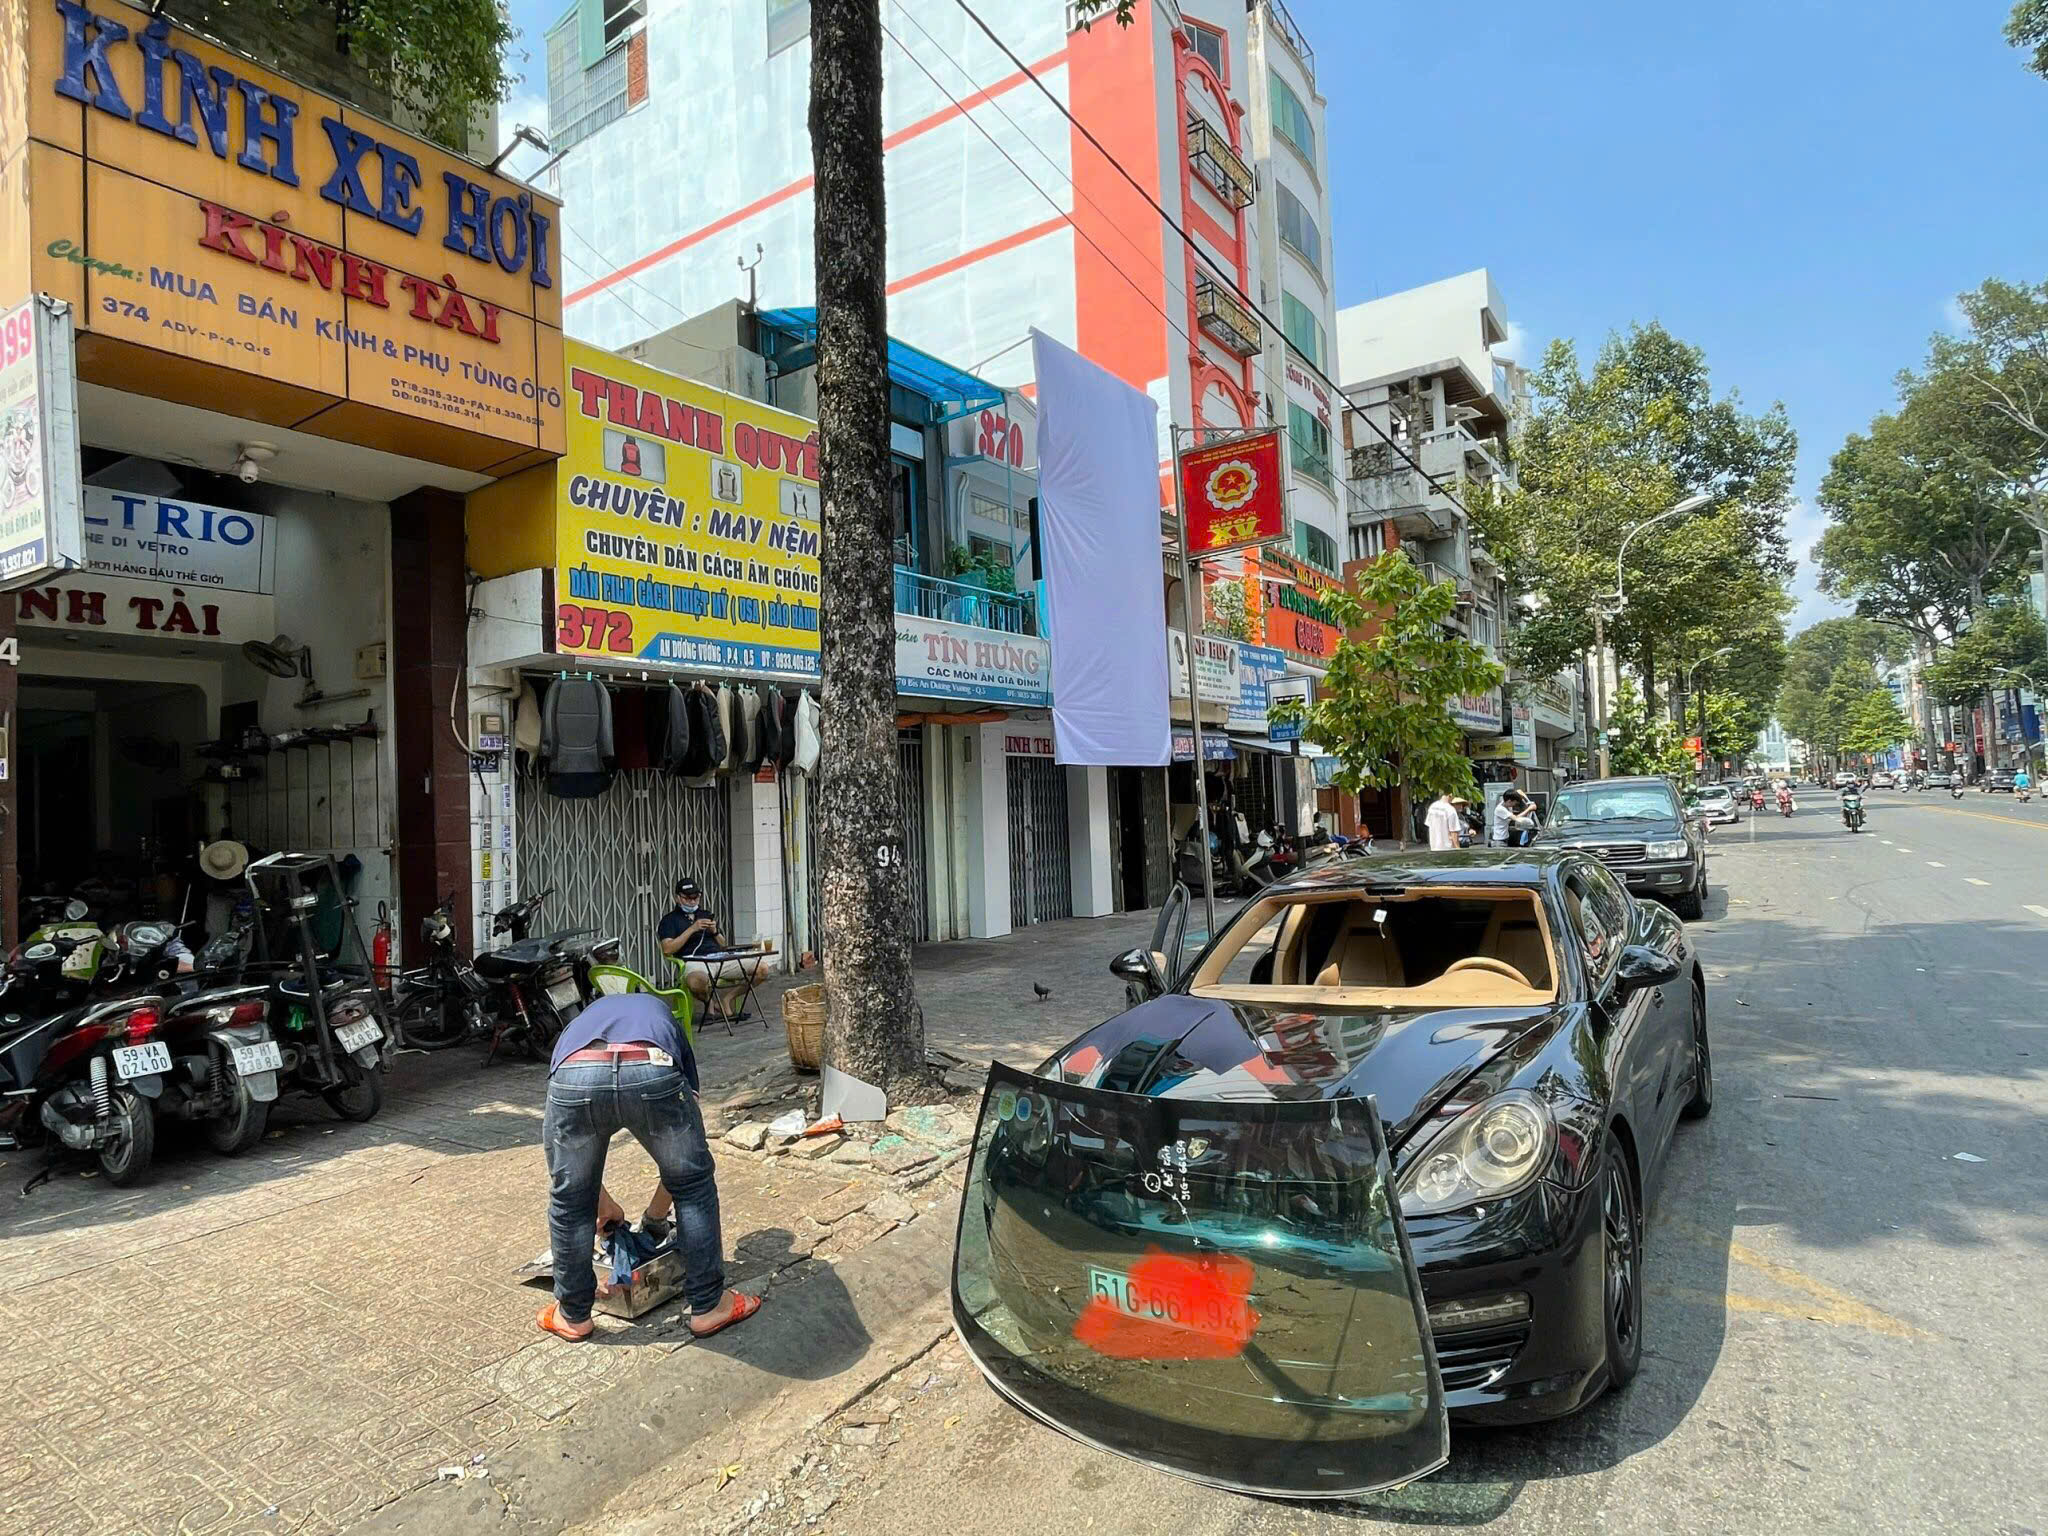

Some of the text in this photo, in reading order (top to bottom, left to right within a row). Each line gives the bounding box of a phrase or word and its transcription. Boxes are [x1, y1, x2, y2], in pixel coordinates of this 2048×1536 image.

[54, 1, 553, 289] KÍNH XE HƠI
[199, 201, 503, 344] KÍNH TÀI
[102, 296, 150, 323] 374
[150, 267, 218, 305] MUA
[238, 296, 298, 329] BÁN
[315, 316, 377, 358] KÍNH
[382, 339, 399, 358] &
[402, 344, 451, 377] PHỤ
[460, 361, 518, 395] TÙNG
[0, 308, 32, 369] 99
[571, 366, 724, 455] THANH
[569, 475, 686, 528] CHUYÊN
[708, 509, 763, 544] MAY
[768, 521, 819, 560] NỆM
[111, 536, 128, 549] DI
[137, 539, 189, 556] VETRO
[586, 530, 819, 594] CHUYÊN DÁN CÁCH ÂM CHỐNG
[128, 587, 221, 636] TÀI
[568, 561, 600, 601] DÁN
[601, 572, 636, 607] FILM
[637, 573, 671, 612] CÁCH
[672, 582, 710, 622] NHIỆT
[738, 596, 760, 625] USA
[768, 593, 790, 629] BẢO
[558, 603, 634, 654] 372
[659, 638, 671, 657] AN
[923, 630, 969, 666] TÍN
[973, 639, 1041, 676] HƯNG
[997, 675, 1015, 686] GIA
[122, 1045, 160, 1062] 59-VA
